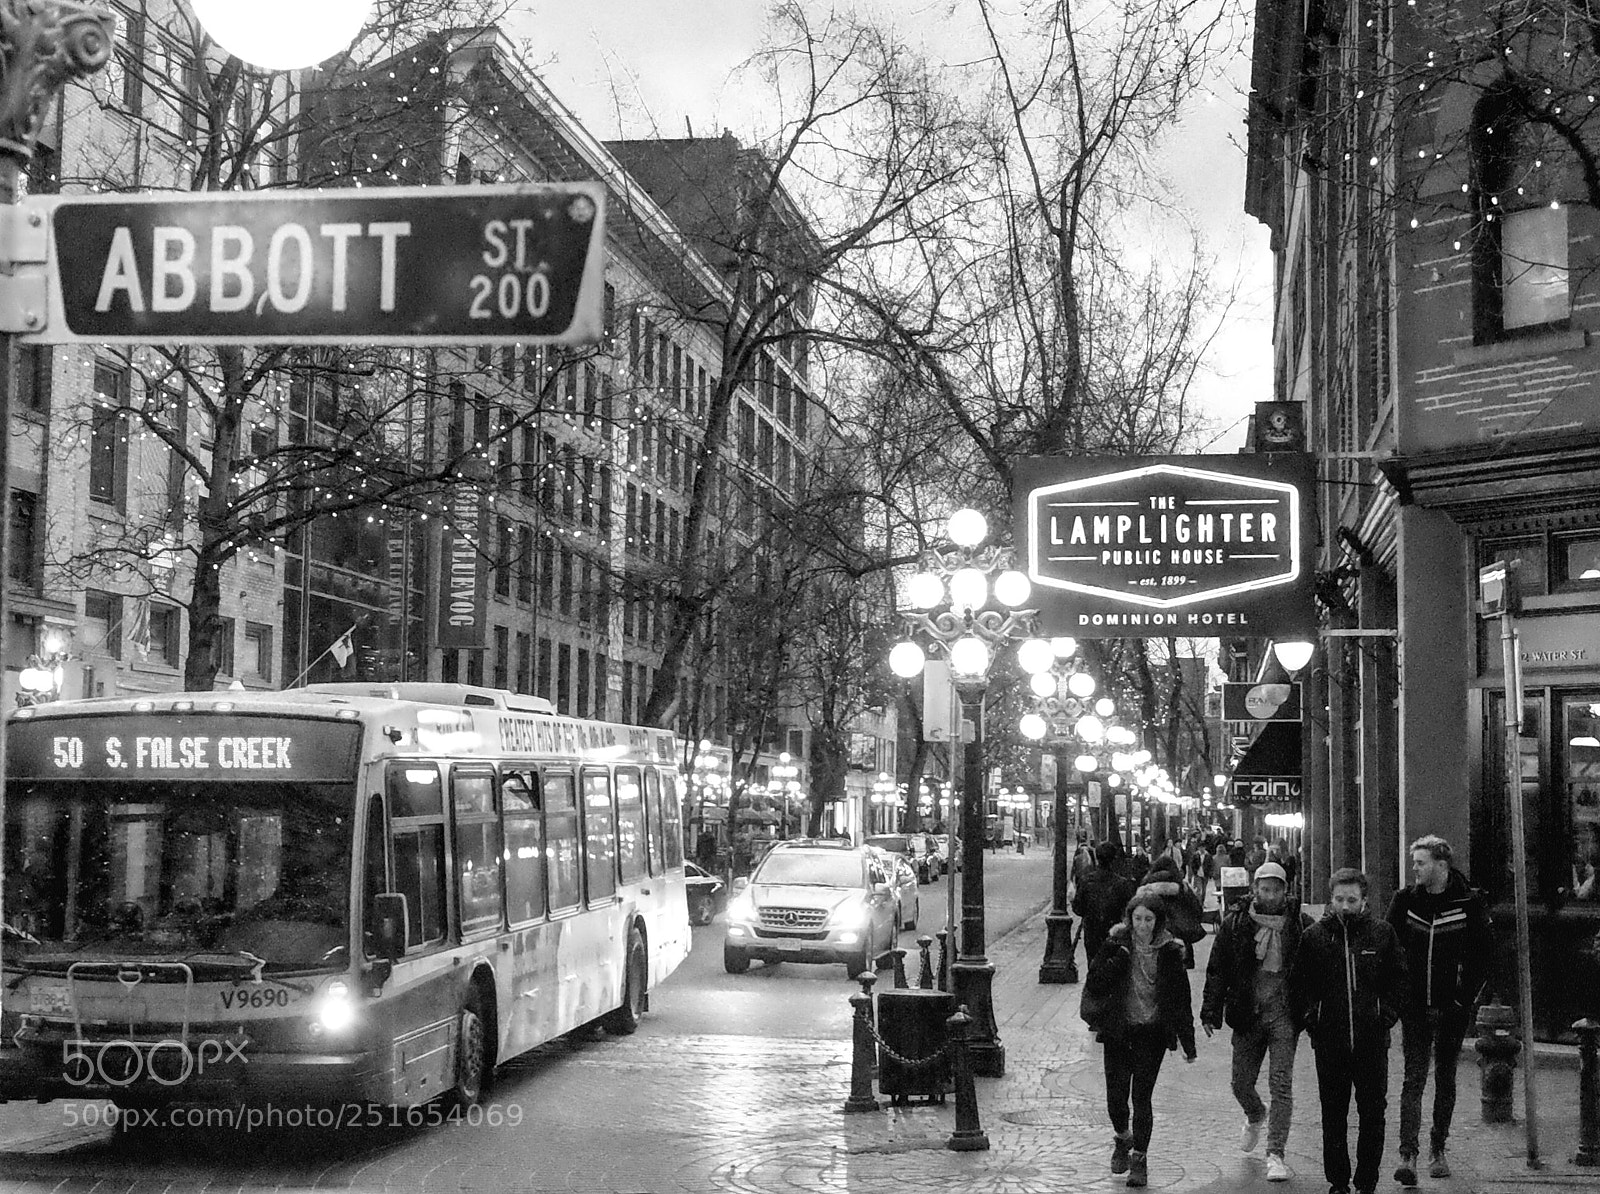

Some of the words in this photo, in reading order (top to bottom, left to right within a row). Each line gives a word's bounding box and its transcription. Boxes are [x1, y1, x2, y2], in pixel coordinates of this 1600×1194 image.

[94, 221, 412, 315] ABBOTT
[469, 273, 550, 319] 200
[1149, 496, 1176, 510] THE
[1050, 512, 1278, 545] LAMPLIGHTER
[1101, 549, 1162, 566] PUBLIC
[1170, 548, 1224, 564] HOUSE
[449, 537, 480, 627] FLUEVOG
[1160, 575, 1187, 586] 1899
[1078, 613, 1178, 626] DOMINION
[1187, 612, 1249, 625] HOTEL
[1532, 650, 1568, 662] WATER
[53, 736, 84, 769] 50
[105, 736, 129, 769] S.
[136, 736, 211, 769] FALSE
[217, 736, 293, 769] CREEK
[1233, 778, 1290, 796] rain
[220, 988, 289, 1009] V9690
